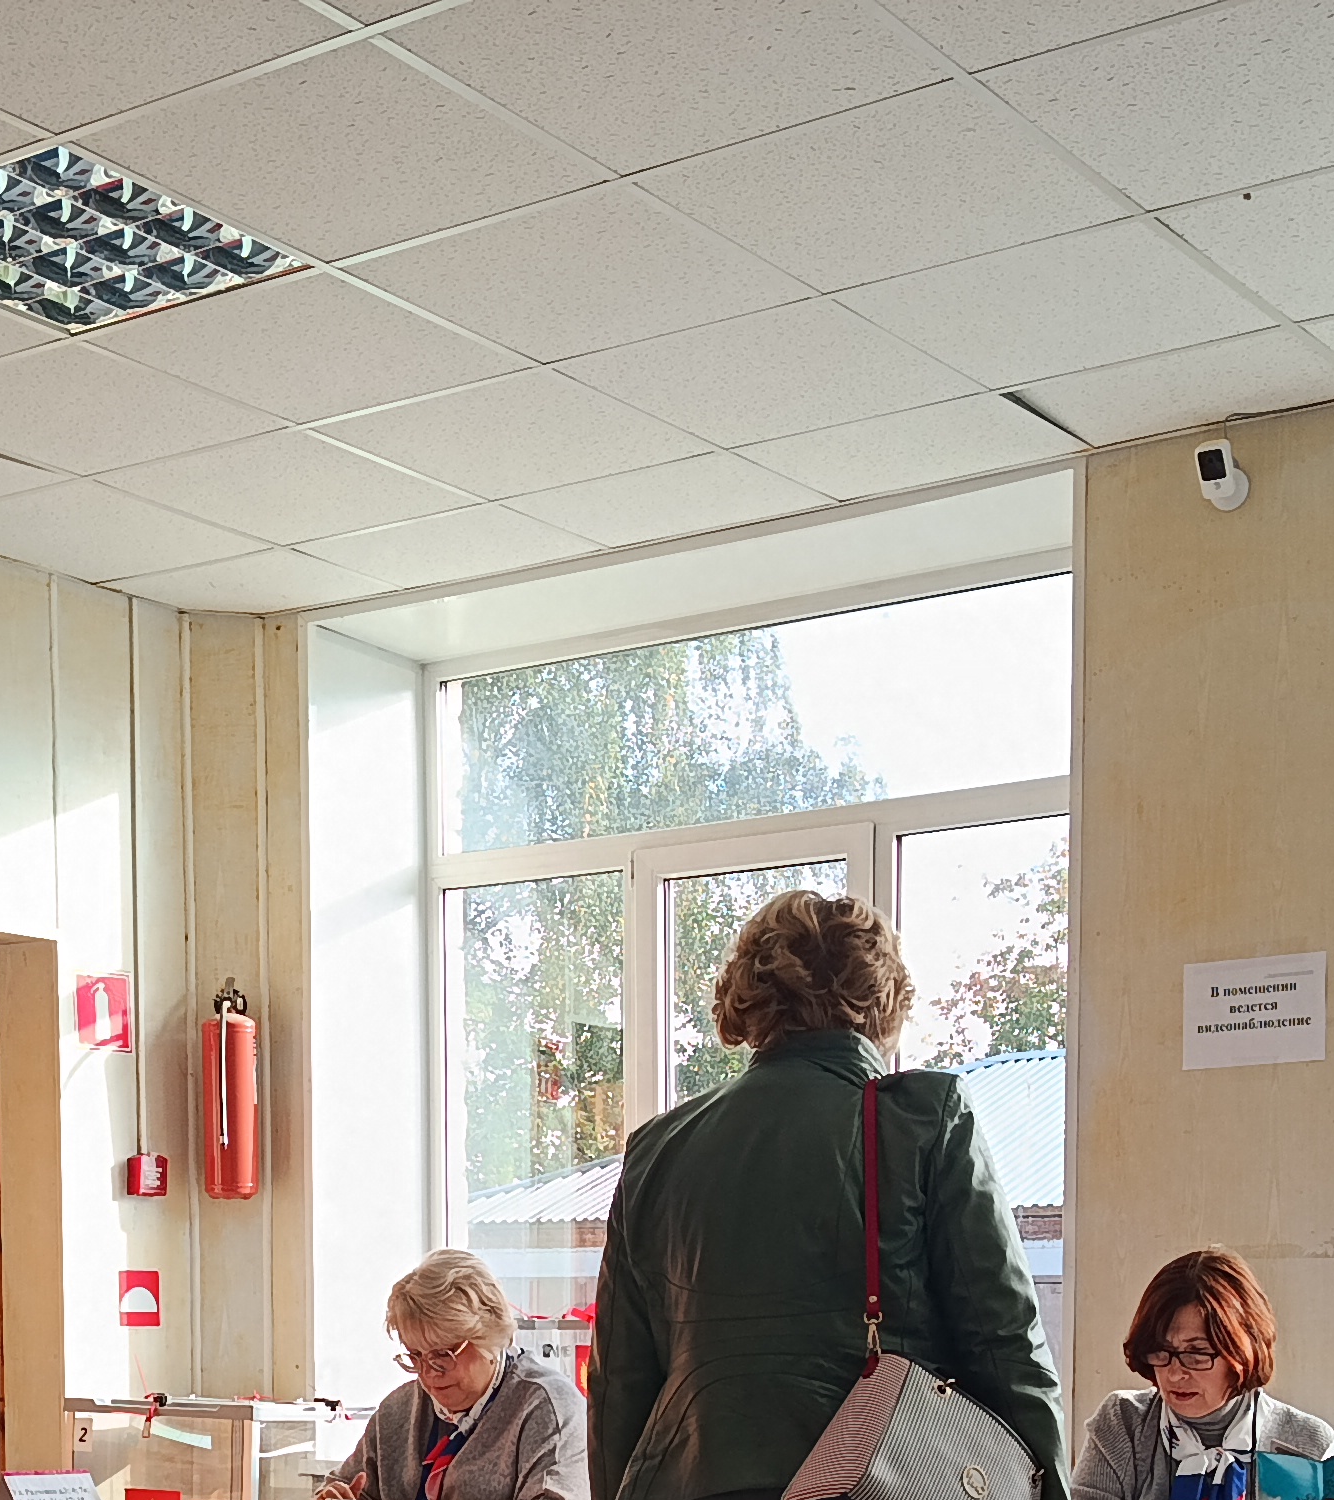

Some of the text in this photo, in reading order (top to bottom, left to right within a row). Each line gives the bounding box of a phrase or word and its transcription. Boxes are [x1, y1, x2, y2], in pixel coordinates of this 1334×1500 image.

[1210, 982, 1297, 998] В помещении
[1197, 1016, 1312, 1034] видеонаблюдение
[78, 1427, 88, 1443] 2
